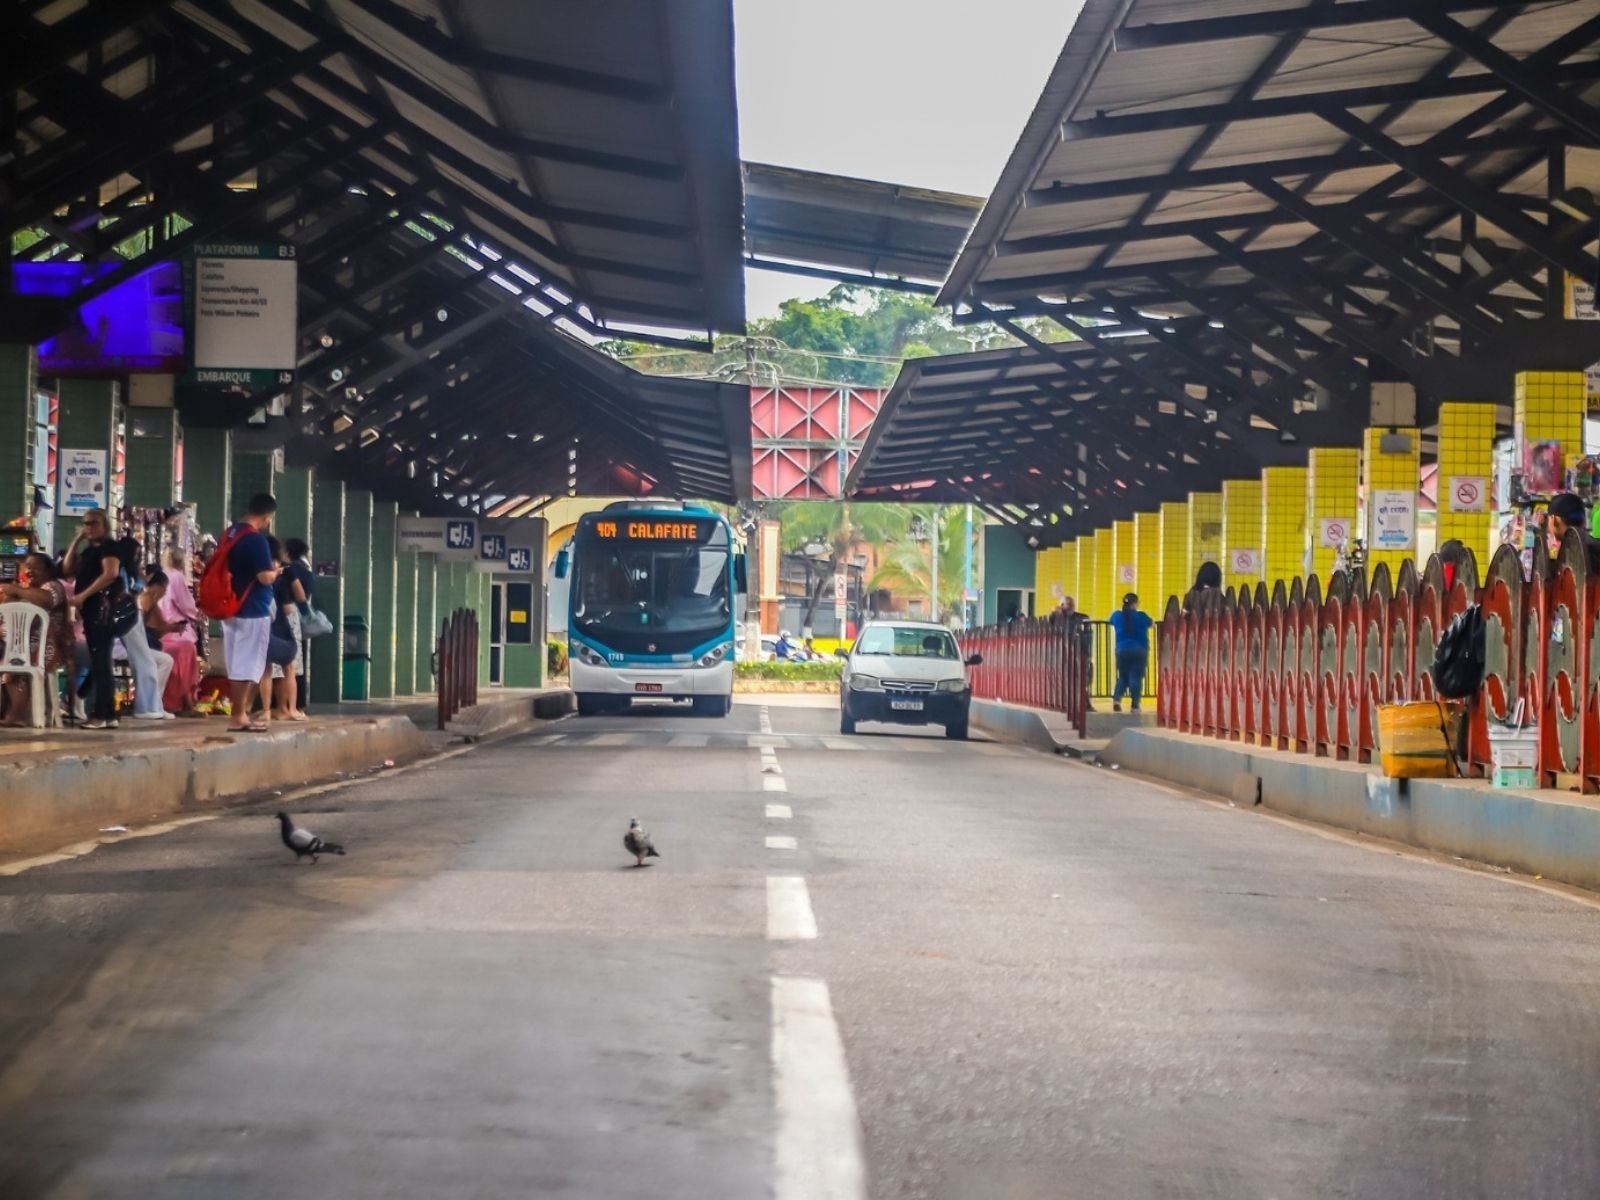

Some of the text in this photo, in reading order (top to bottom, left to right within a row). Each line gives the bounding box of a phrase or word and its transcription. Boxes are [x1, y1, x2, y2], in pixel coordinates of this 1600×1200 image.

[193, 244, 259, 256] PLATAFORMA
[197, 371, 251, 384] EMBARQUE
[598, 523, 697, 539] 404 CALAFATE
